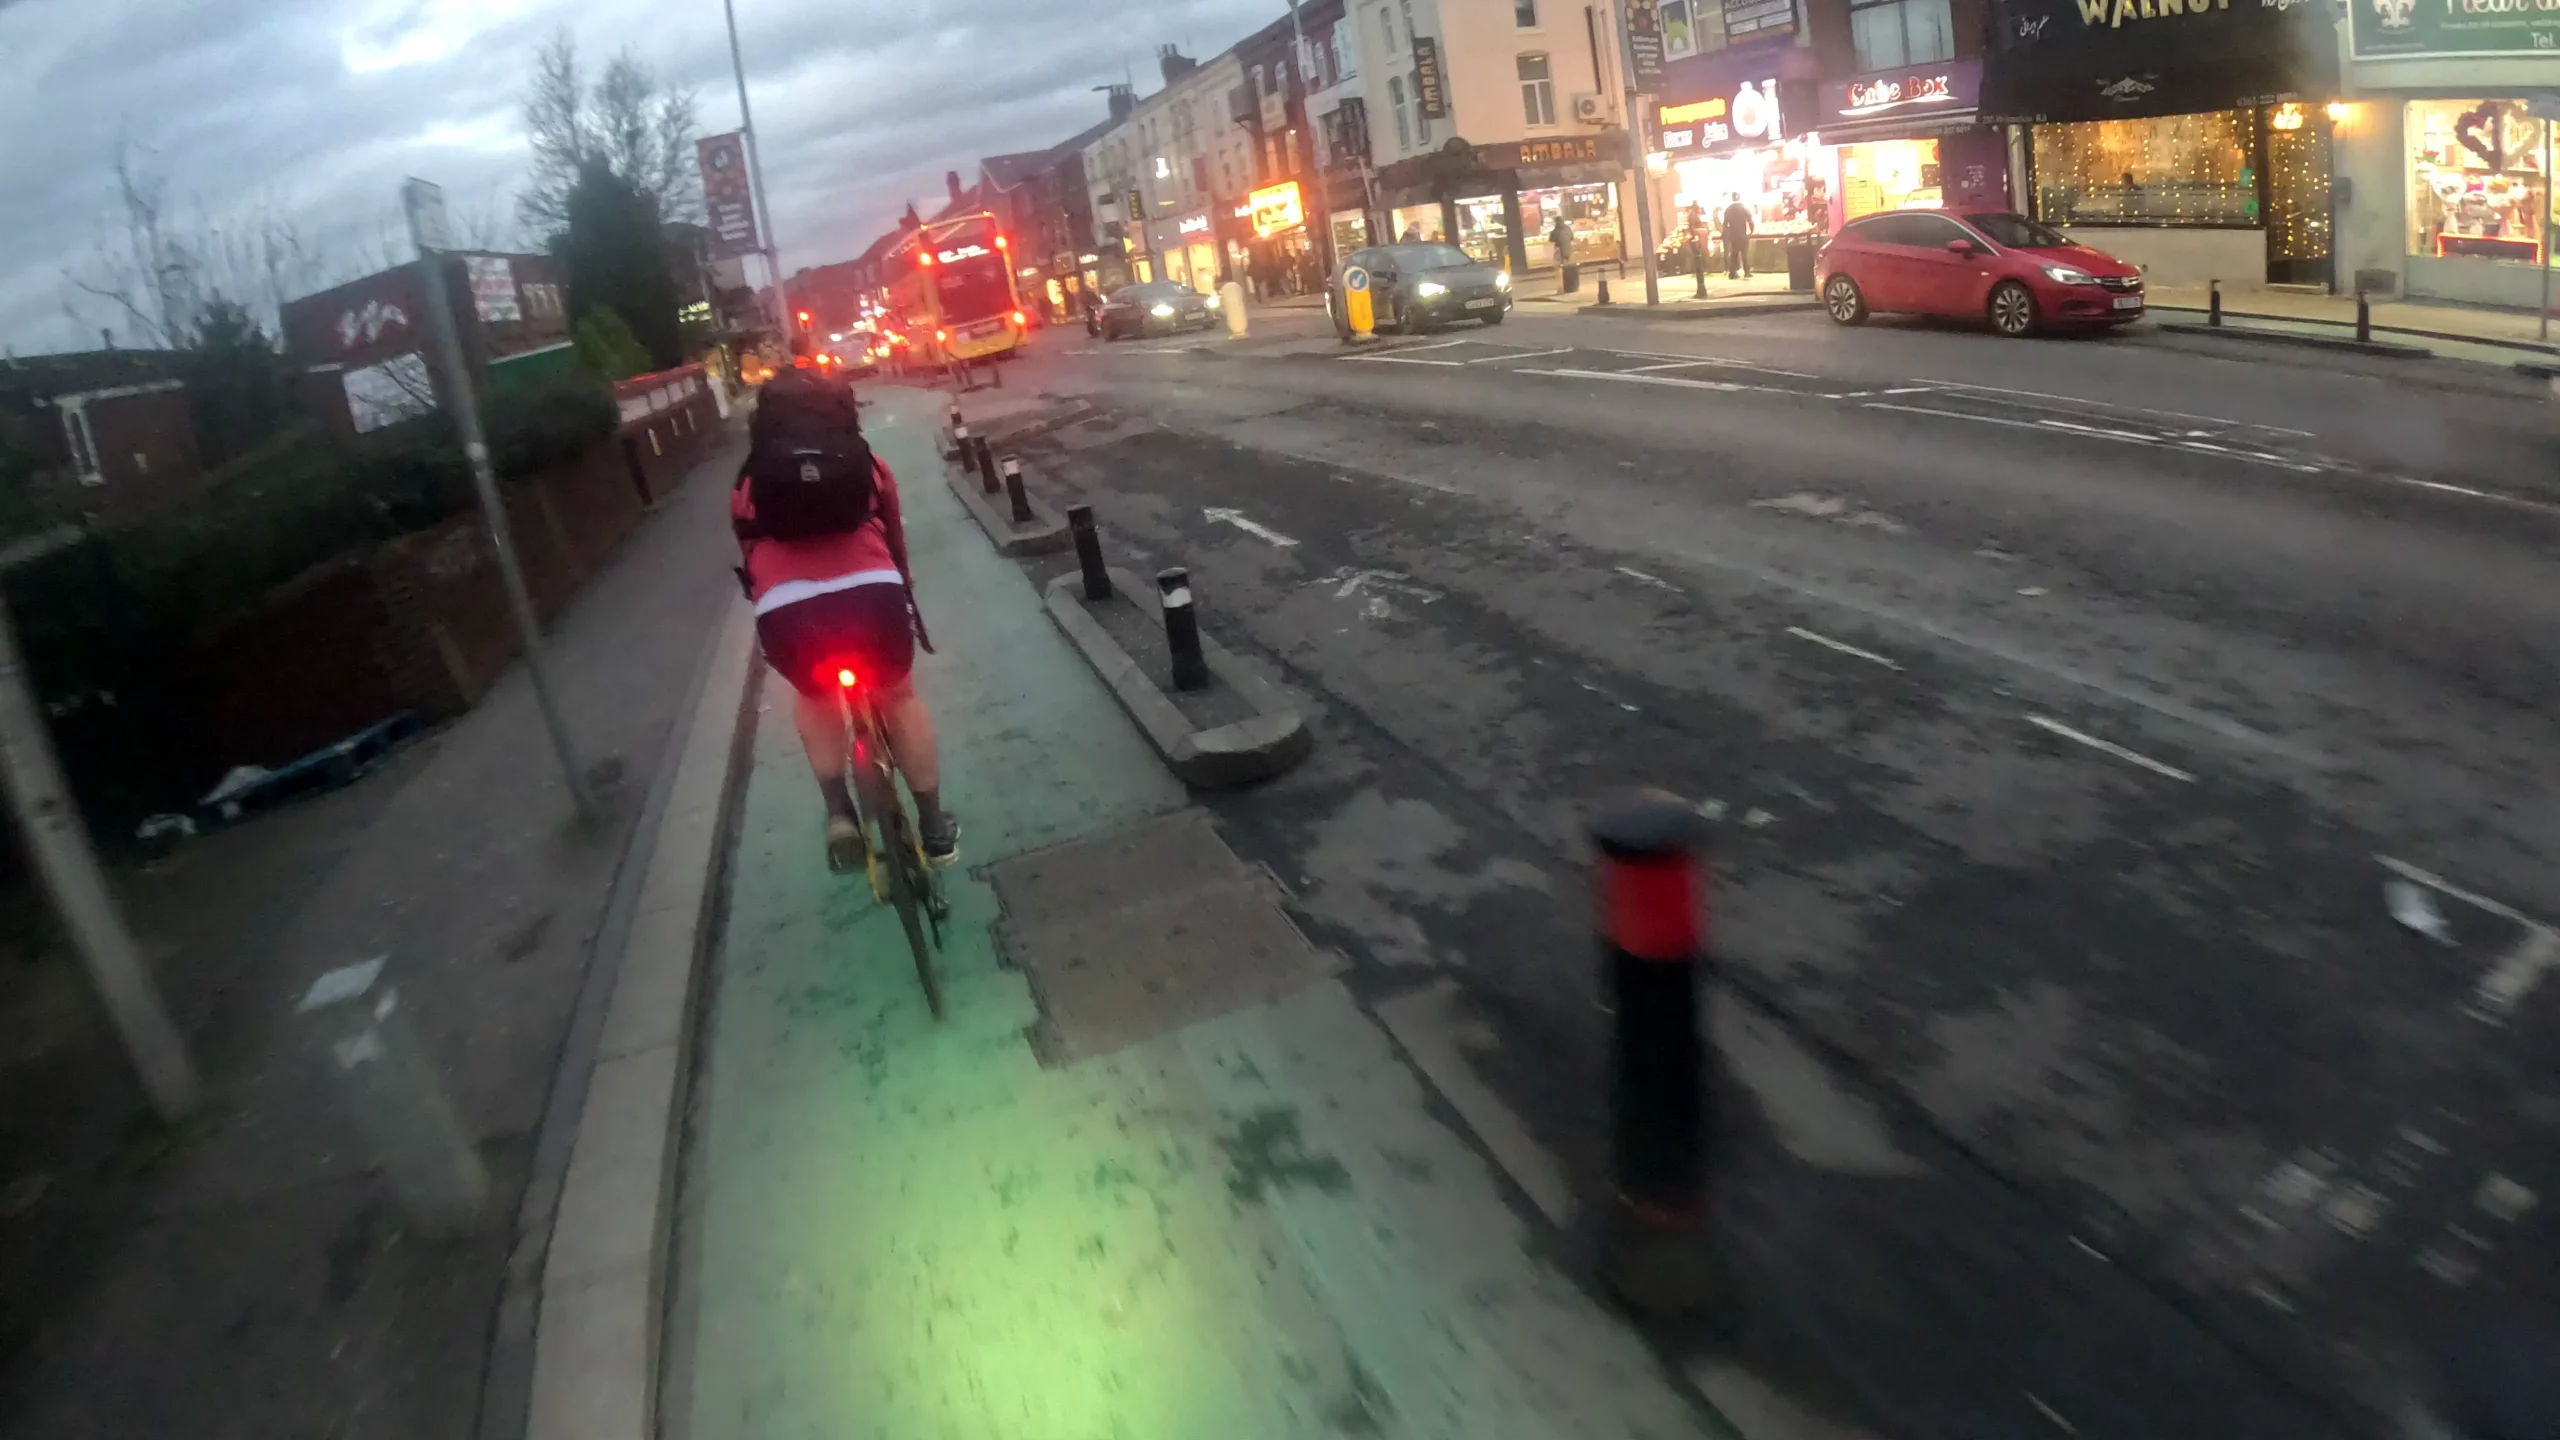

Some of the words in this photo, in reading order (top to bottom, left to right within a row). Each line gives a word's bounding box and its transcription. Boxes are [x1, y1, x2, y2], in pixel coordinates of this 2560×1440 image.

[2076, 0, 2231, 28] WALN
[1417, 46, 1440, 112] AMBALA
[1847, 79, 1902, 107] Cake
[1905, 75, 1949, 98] Box
[1519, 139, 1597, 164] AMBALA
